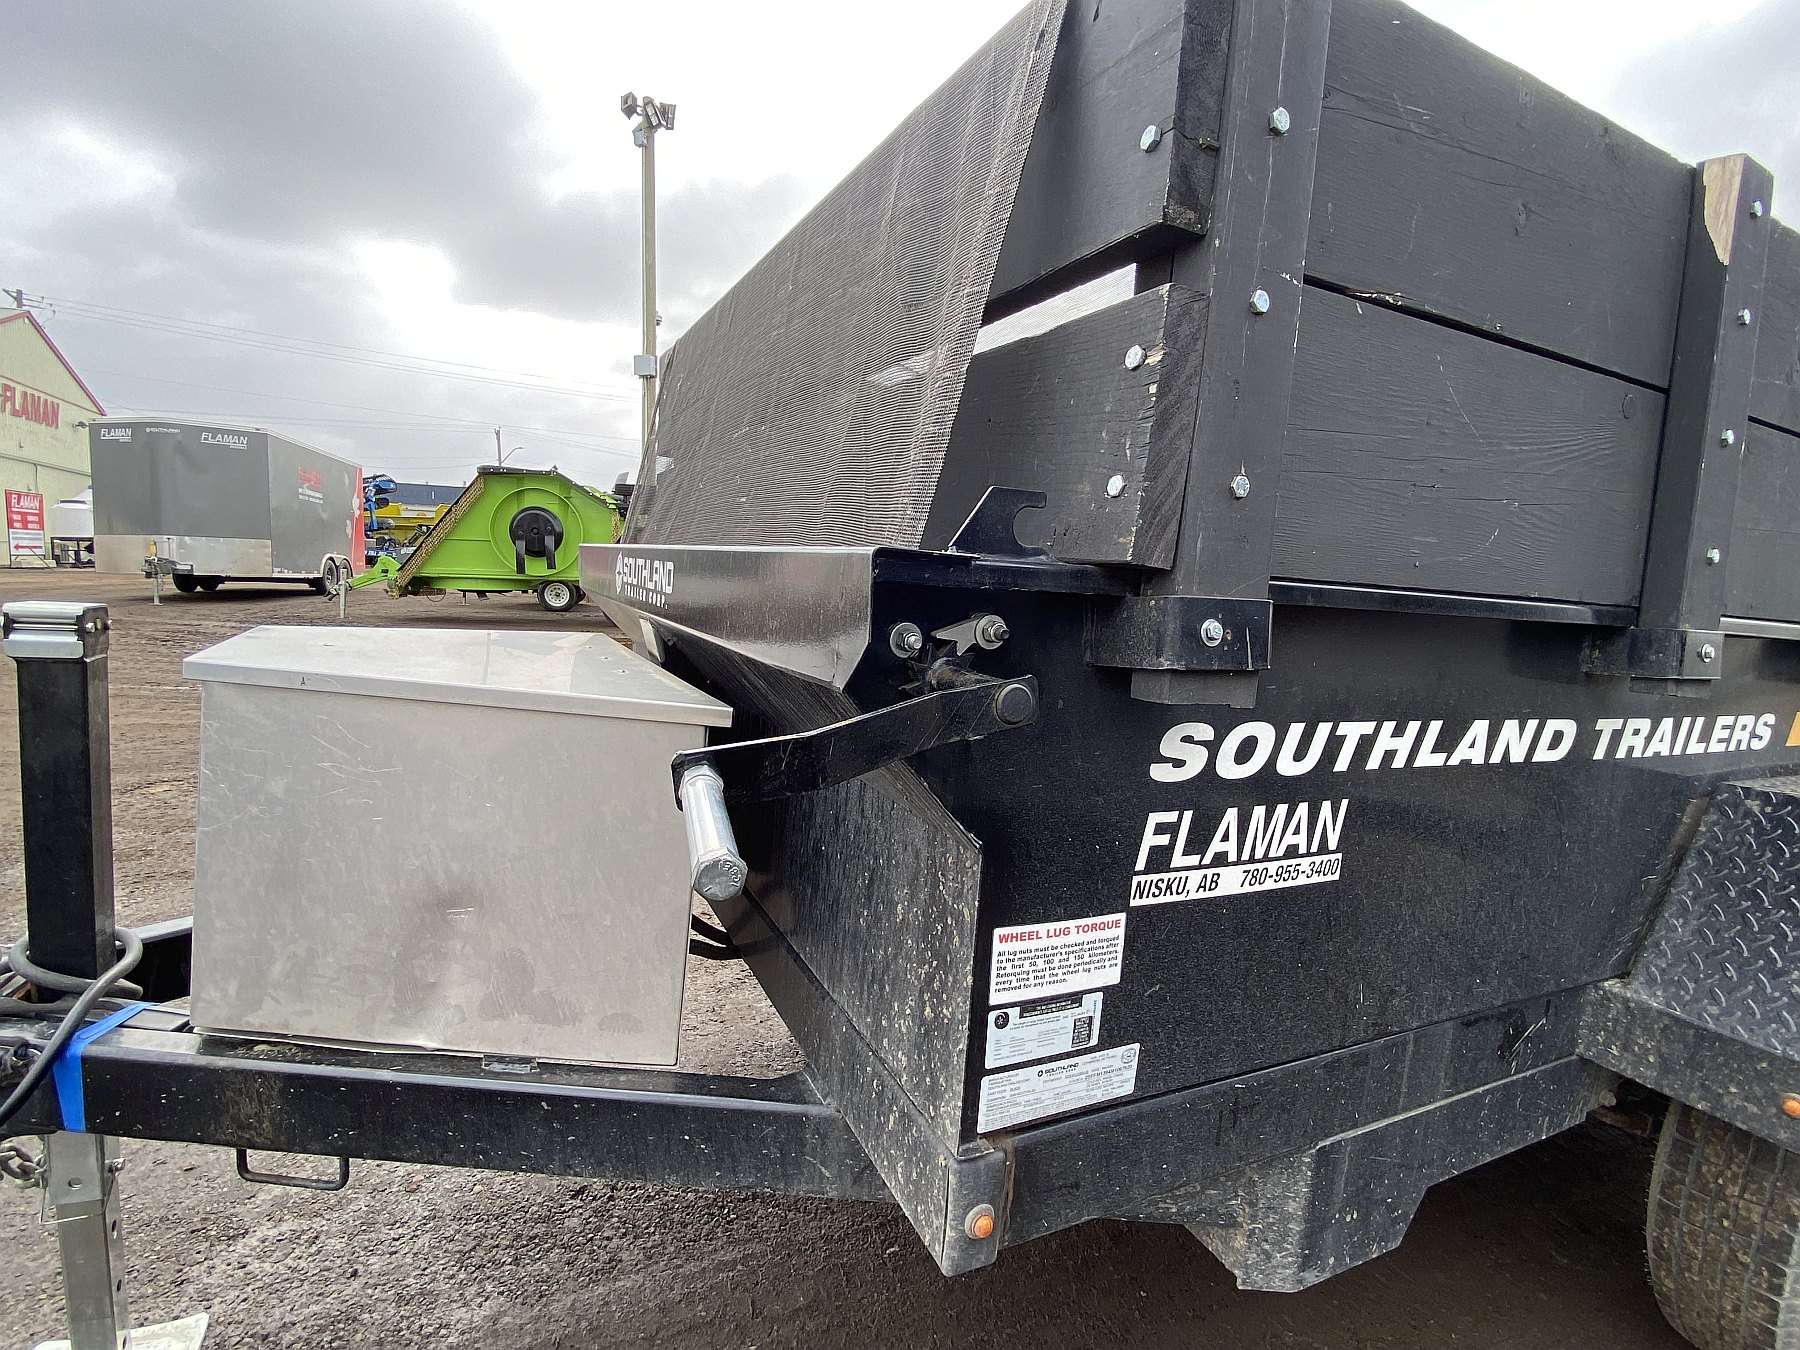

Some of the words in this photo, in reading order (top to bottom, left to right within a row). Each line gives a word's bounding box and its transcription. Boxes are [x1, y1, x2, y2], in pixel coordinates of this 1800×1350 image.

[2, 383, 60, 429] FLAMAN
[101, 428, 132, 437] FLAMAN
[201, 432, 248, 445] FLAMAN
[623, 556, 674, 594] SOUTHLAND
[1149, 718, 1577, 782] SOUTHLAND
[1590, 713, 1776, 760] TRAILERS
[1134, 798, 1349, 872] FLAMAN
[1132, 876, 1189, 900] NISKU,
[1196, 873, 1220, 893] AB
[1240, 858, 1340, 888] 780-955-3400
[998, 930, 1042, 944] WHEEL
[1046, 926, 1071, 939] LUG
[1074, 919, 1121, 935] TORQUE
[1007, 949, 1017, 957] lug
[1034, 945, 1050, 953] must
[1060, 940, 1085, 949] checked
[1098, 934, 1119, 944] torqued
[1016, 950, 1063, 962] manufacturer's
[1064, 945, 1104, 957] specifications
[995, 969, 1030, 980] Retorquing
[1057, 962, 1072, 970] done
[1073, 957, 1106, 968] periodically
[995, 979, 1012, 987] every
[1033, 973, 1046, 981] that
[1061, 968, 1079, 976] wheel
[1082, 966, 1092, 974] lug
[994, 984, 1021, 994] removed
[1045, 978, 1068, 986] reason.
